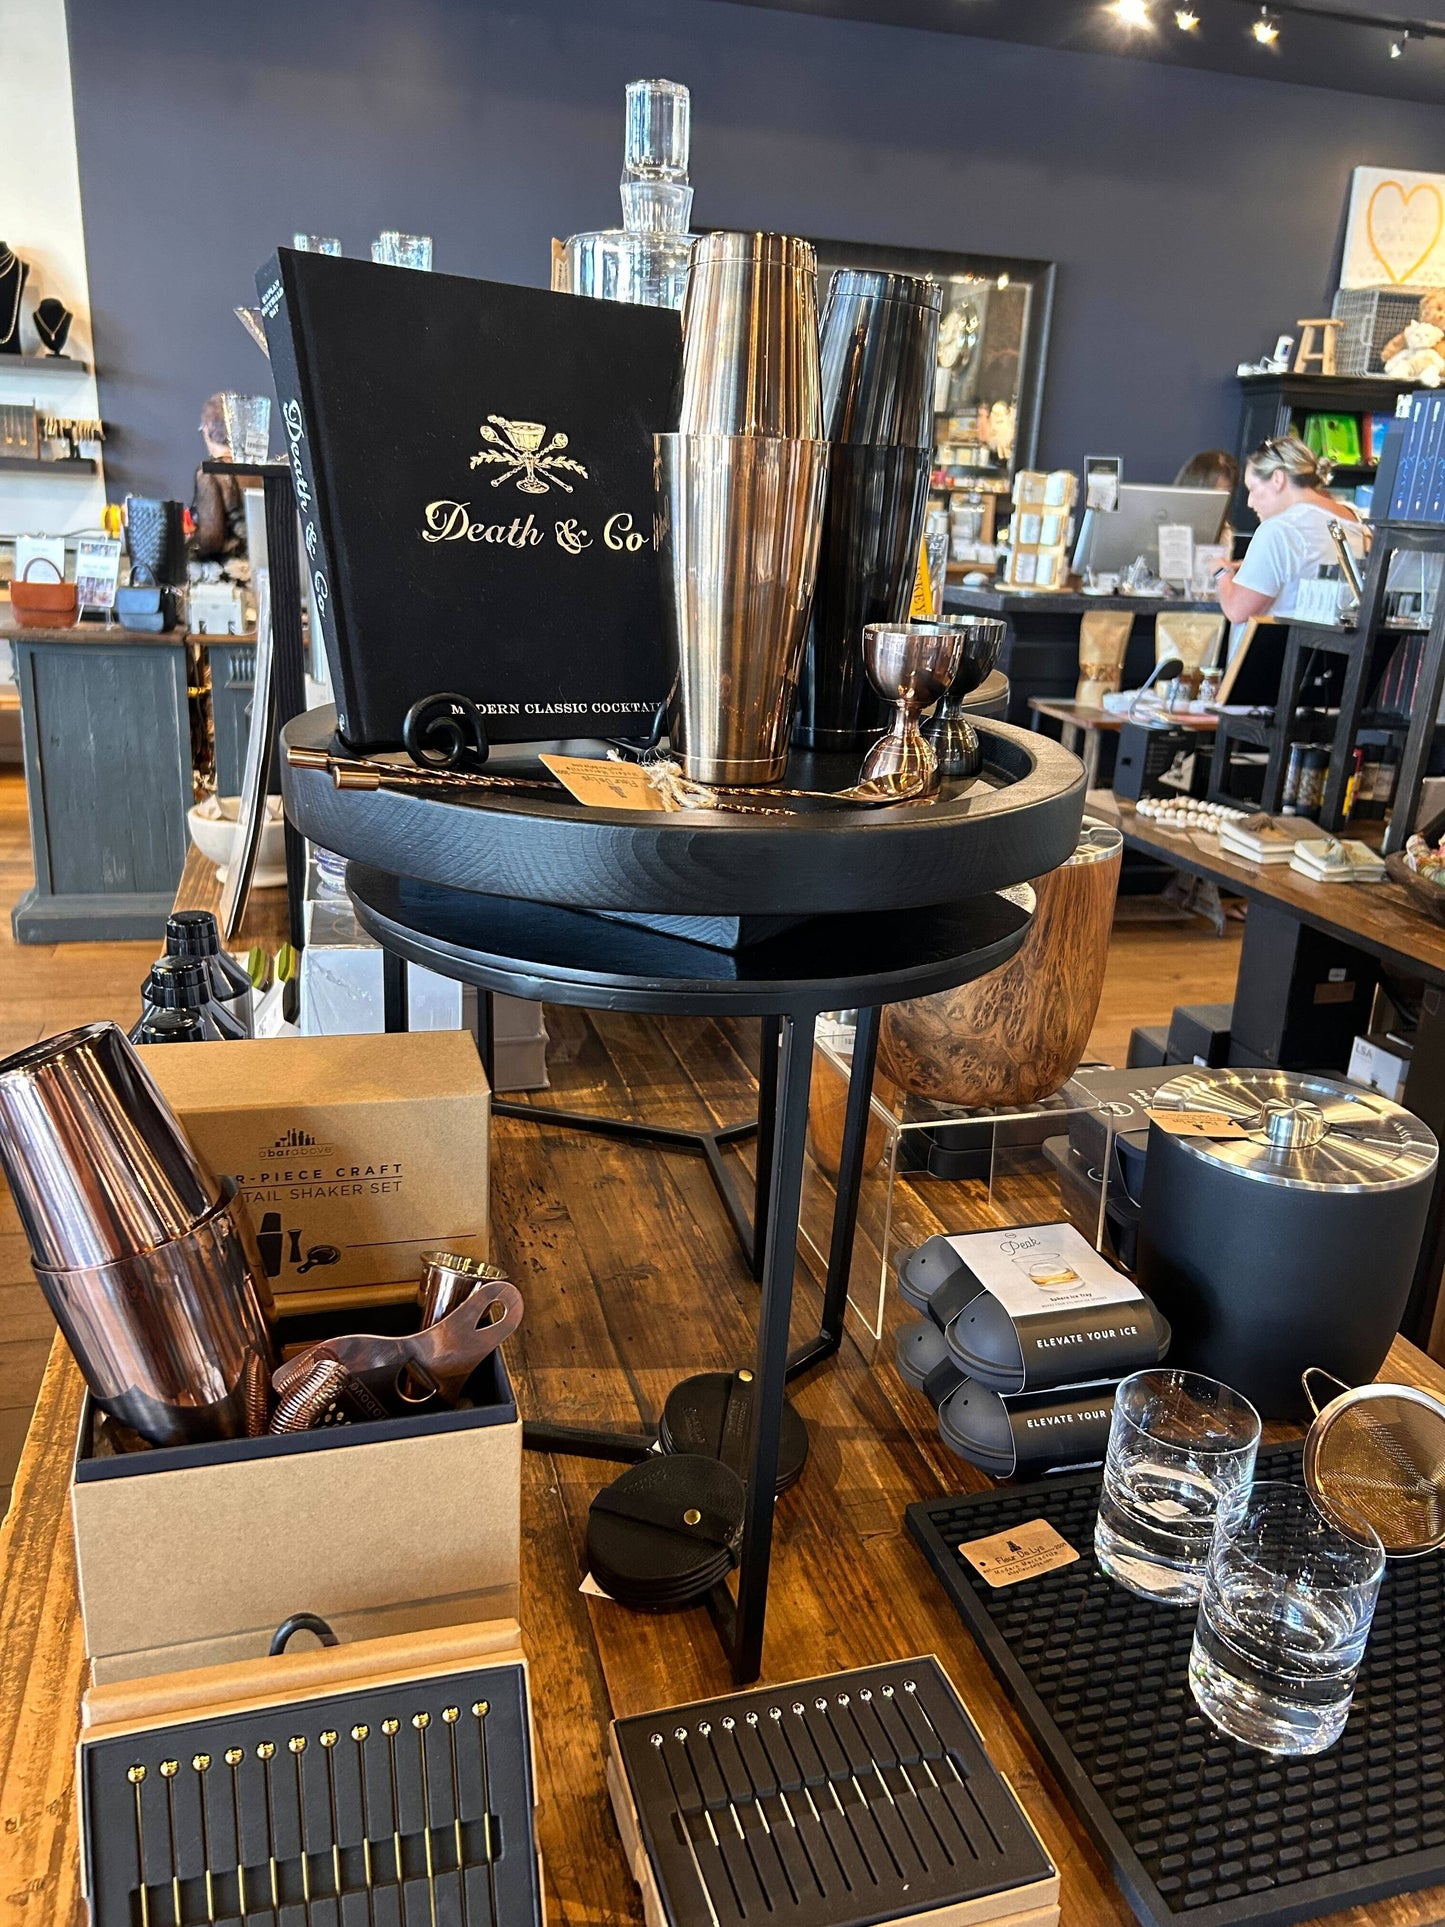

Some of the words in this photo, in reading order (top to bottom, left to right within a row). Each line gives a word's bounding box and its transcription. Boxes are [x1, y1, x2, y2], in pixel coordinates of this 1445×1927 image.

[283, 399, 313, 513] Death
[305, 521, 318, 561] &
[421, 500, 545, 549] Death
[554, 518, 594, 555] &
[603, 512, 650, 552] Co
[451, 703, 520, 715] MDERN
[524, 702, 588, 714] CLASSIC
[336, 1163, 402, 1177] CRAFT
[290, 1184, 363, 1200] SHAKER
[370, 1181, 402, 1194] SET
[1000, 1236, 1041, 1256] Peak
[1036, 1334, 1083, 1348] ELEVATE
[1087, 1330, 1116, 1341] YOUR
[1120, 1326, 1138, 1336] ICE
[1027, 1414, 1074, 1428] ELEVATE
[1077, 1410, 1107, 1421] YOUR
[995, 1554, 1017, 1565] Fleur
[1030, 1545, 1046, 1556] Lys
